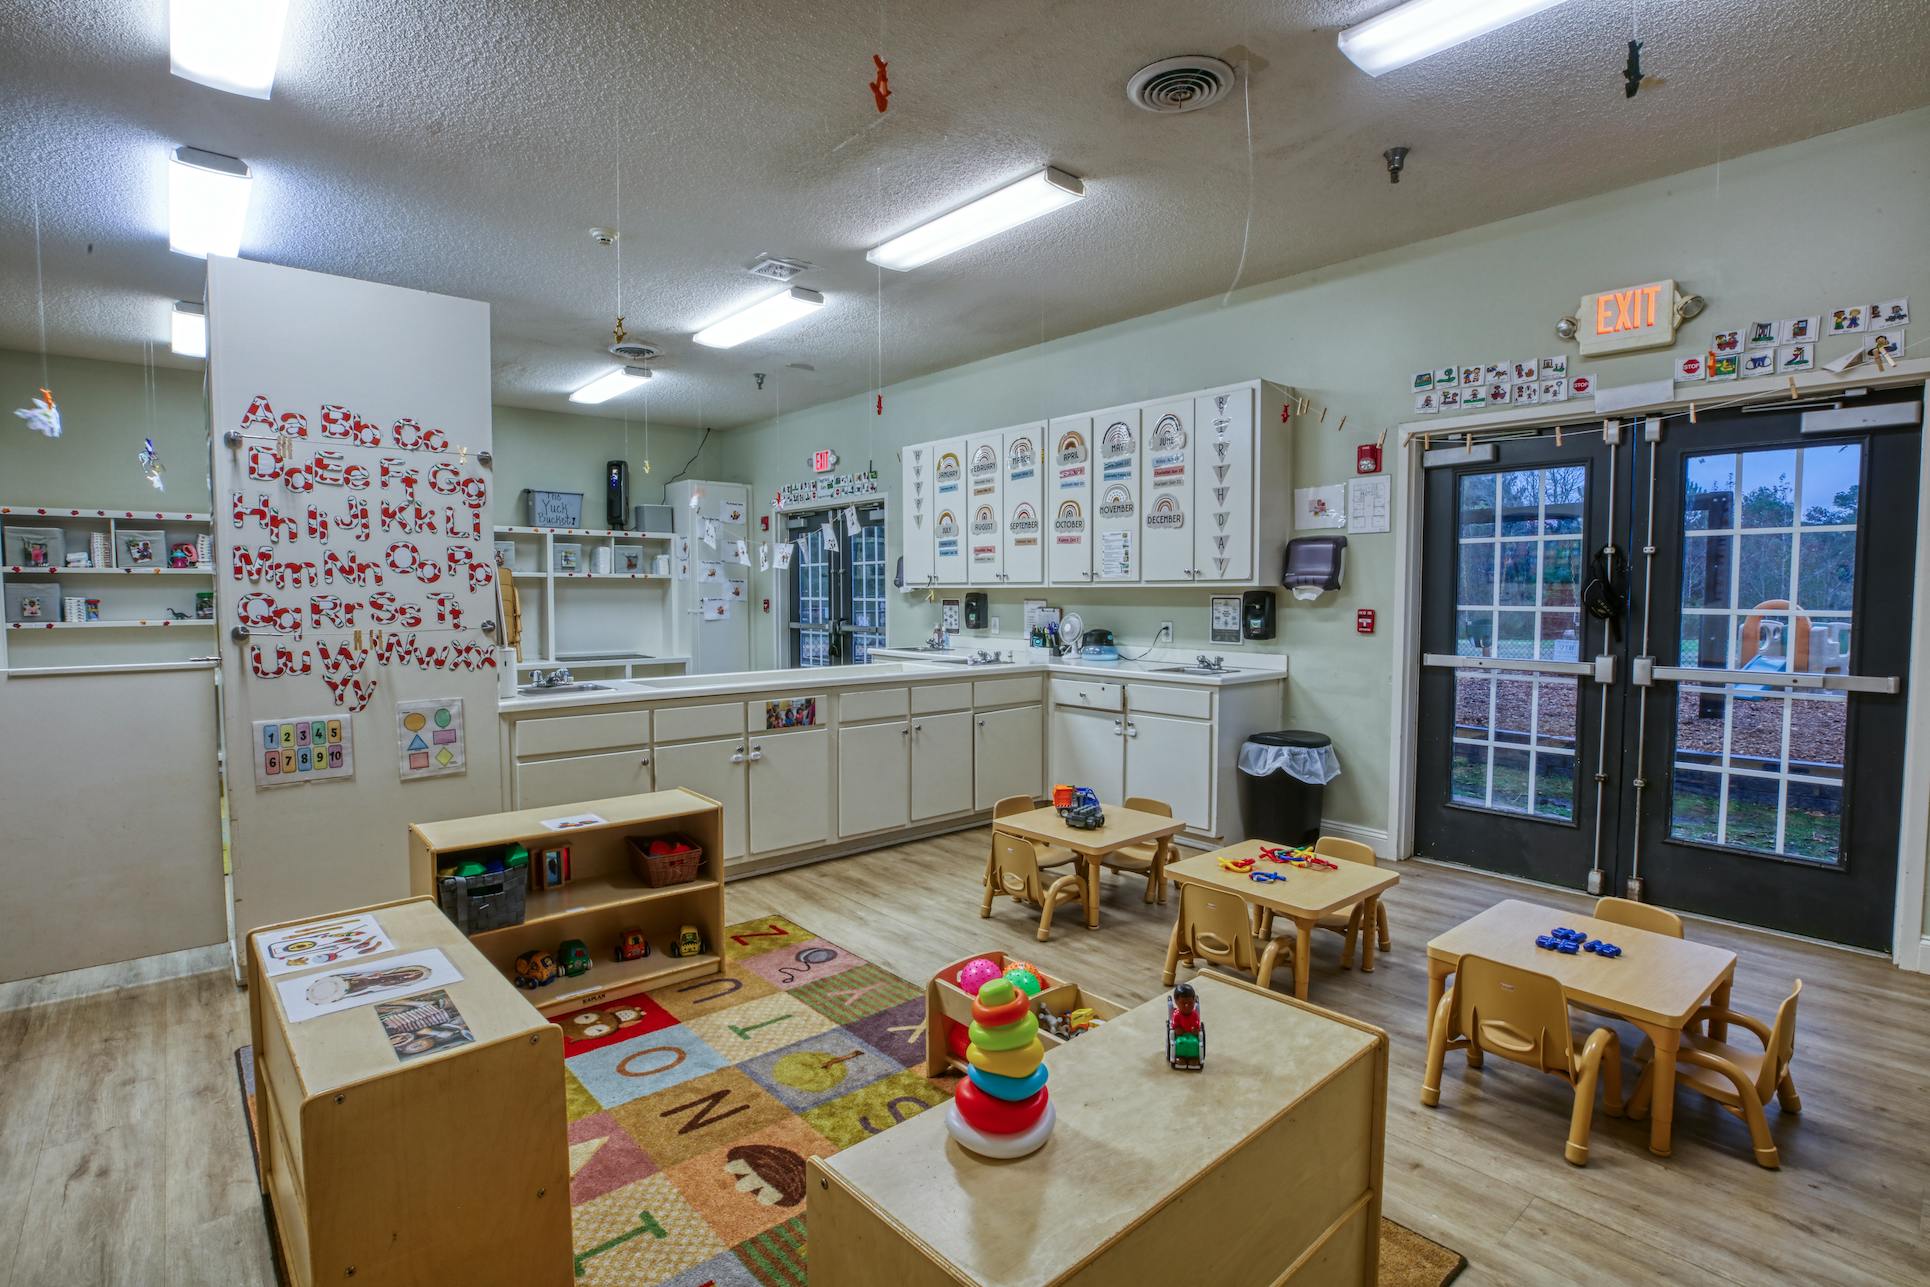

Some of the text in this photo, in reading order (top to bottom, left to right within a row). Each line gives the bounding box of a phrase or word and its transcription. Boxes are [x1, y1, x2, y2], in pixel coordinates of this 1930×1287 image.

[1597, 285, 1661, 336] EXIT
[1683, 361, 1700, 370] STOP
[240, 395, 448, 452] Aa Bb Cc
[1111, 444, 1124, 453] MAY
[1159, 437, 1174, 446] JUNE
[816, 450, 828, 470] EXIT
[1063, 451, 1079, 461] APRIL
[249, 446, 486, 508] Dd Ee Ff Gg
[1100, 504, 1134, 514] NOVEMBER
[233, 492, 298, 544] Hh
[334, 496, 370, 541] Jj
[381, 500, 438, 534] Kk
[1010, 521, 1039, 530] SEPTEMBER
[1056, 520, 1083, 529] OCTOBER
[1147, 515, 1181, 524] DECEMBER
[233, 541, 493, 592] Mm Nn Oo Pp
[238, 592, 466, 641] Qq Rr Ss Tt
[251, 644, 312, 679] Uu
[374, 632, 449, 670] Ww
[449, 639, 496, 672] Xx
[323, 672, 377, 713] Yy
[268, 728, 337, 744] 1 2 3 4 5
[269, 751, 341, 768] 6 7 8 9 10
[582, 993, 606, 1004] KAPLAN
[616, 1046, 750, 1134] N O
